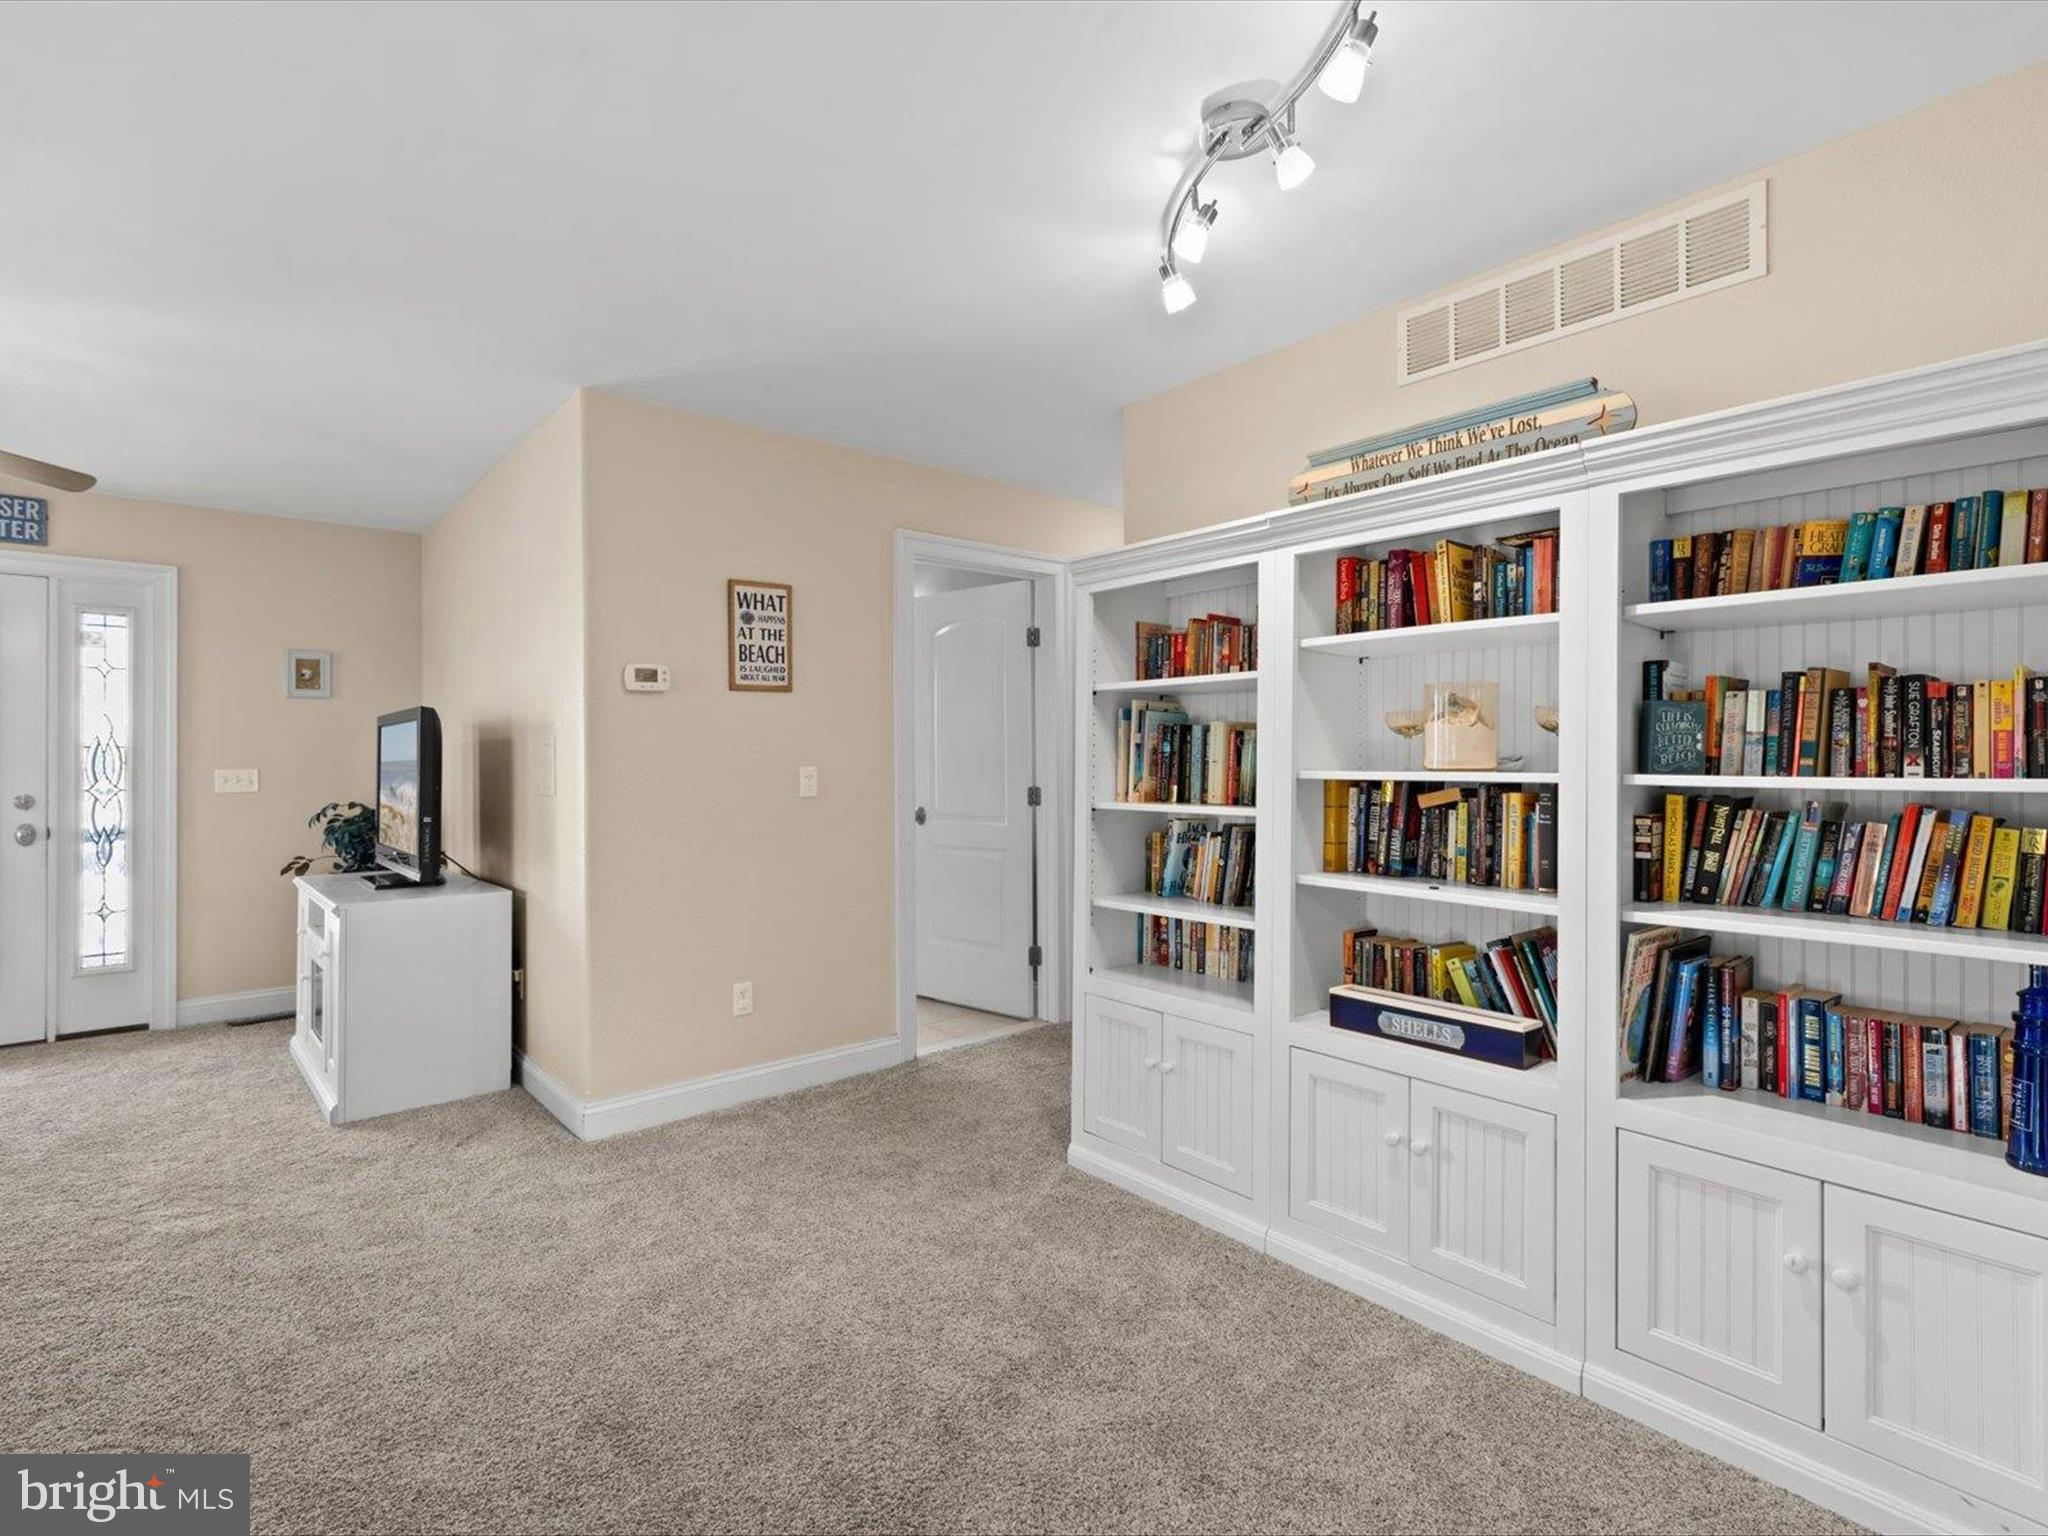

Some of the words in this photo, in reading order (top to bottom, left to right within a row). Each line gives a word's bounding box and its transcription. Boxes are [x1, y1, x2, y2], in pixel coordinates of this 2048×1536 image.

[1350, 450, 1403, 473] Whatever
[1406, 442, 1423, 459] We
[1428, 431, 1463, 455] Think
[1467, 423, 1505, 444] We've
[1509, 414, 1542, 436] Lost,
[1324, 486, 1339, 499] It's
[1342, 479, 1380, 496] Always
[1382, 472, 1404, 486] Our
[1408, 462, 1431, 480] Self
[1433, 460, 1451, 474] We
[1455, 451, 1482, 469] Find
[1487, 448, 1500, 462] At
[1505, 438, 1531, 458] The
[1535, 434, 1579, 452] Ocean
[736, 592, 786, 612] WHAT
[757, 615, 785, 624] HAPPENS
[737, 626, 755, 640] AT
[759, 628, 785, 641] THE
[739, 643, 785, 664] BEACH
[749, 665, 786, 673] LAUGHED
[1908, 681, 1920, 699] SUE
[1907, 700, 1920, 748] GRAFTON
[1661, 751, 1696, 765] BEACH
[1932, 729, 1941, 777] SEABISCUIT
[1797, 831, 1812, 868] BETTING
[1795, 869, 1805, 883] ON
[1792, 884, 1803, 903] YOU
[1391, 1017, 1451, 1043] SHELLS
